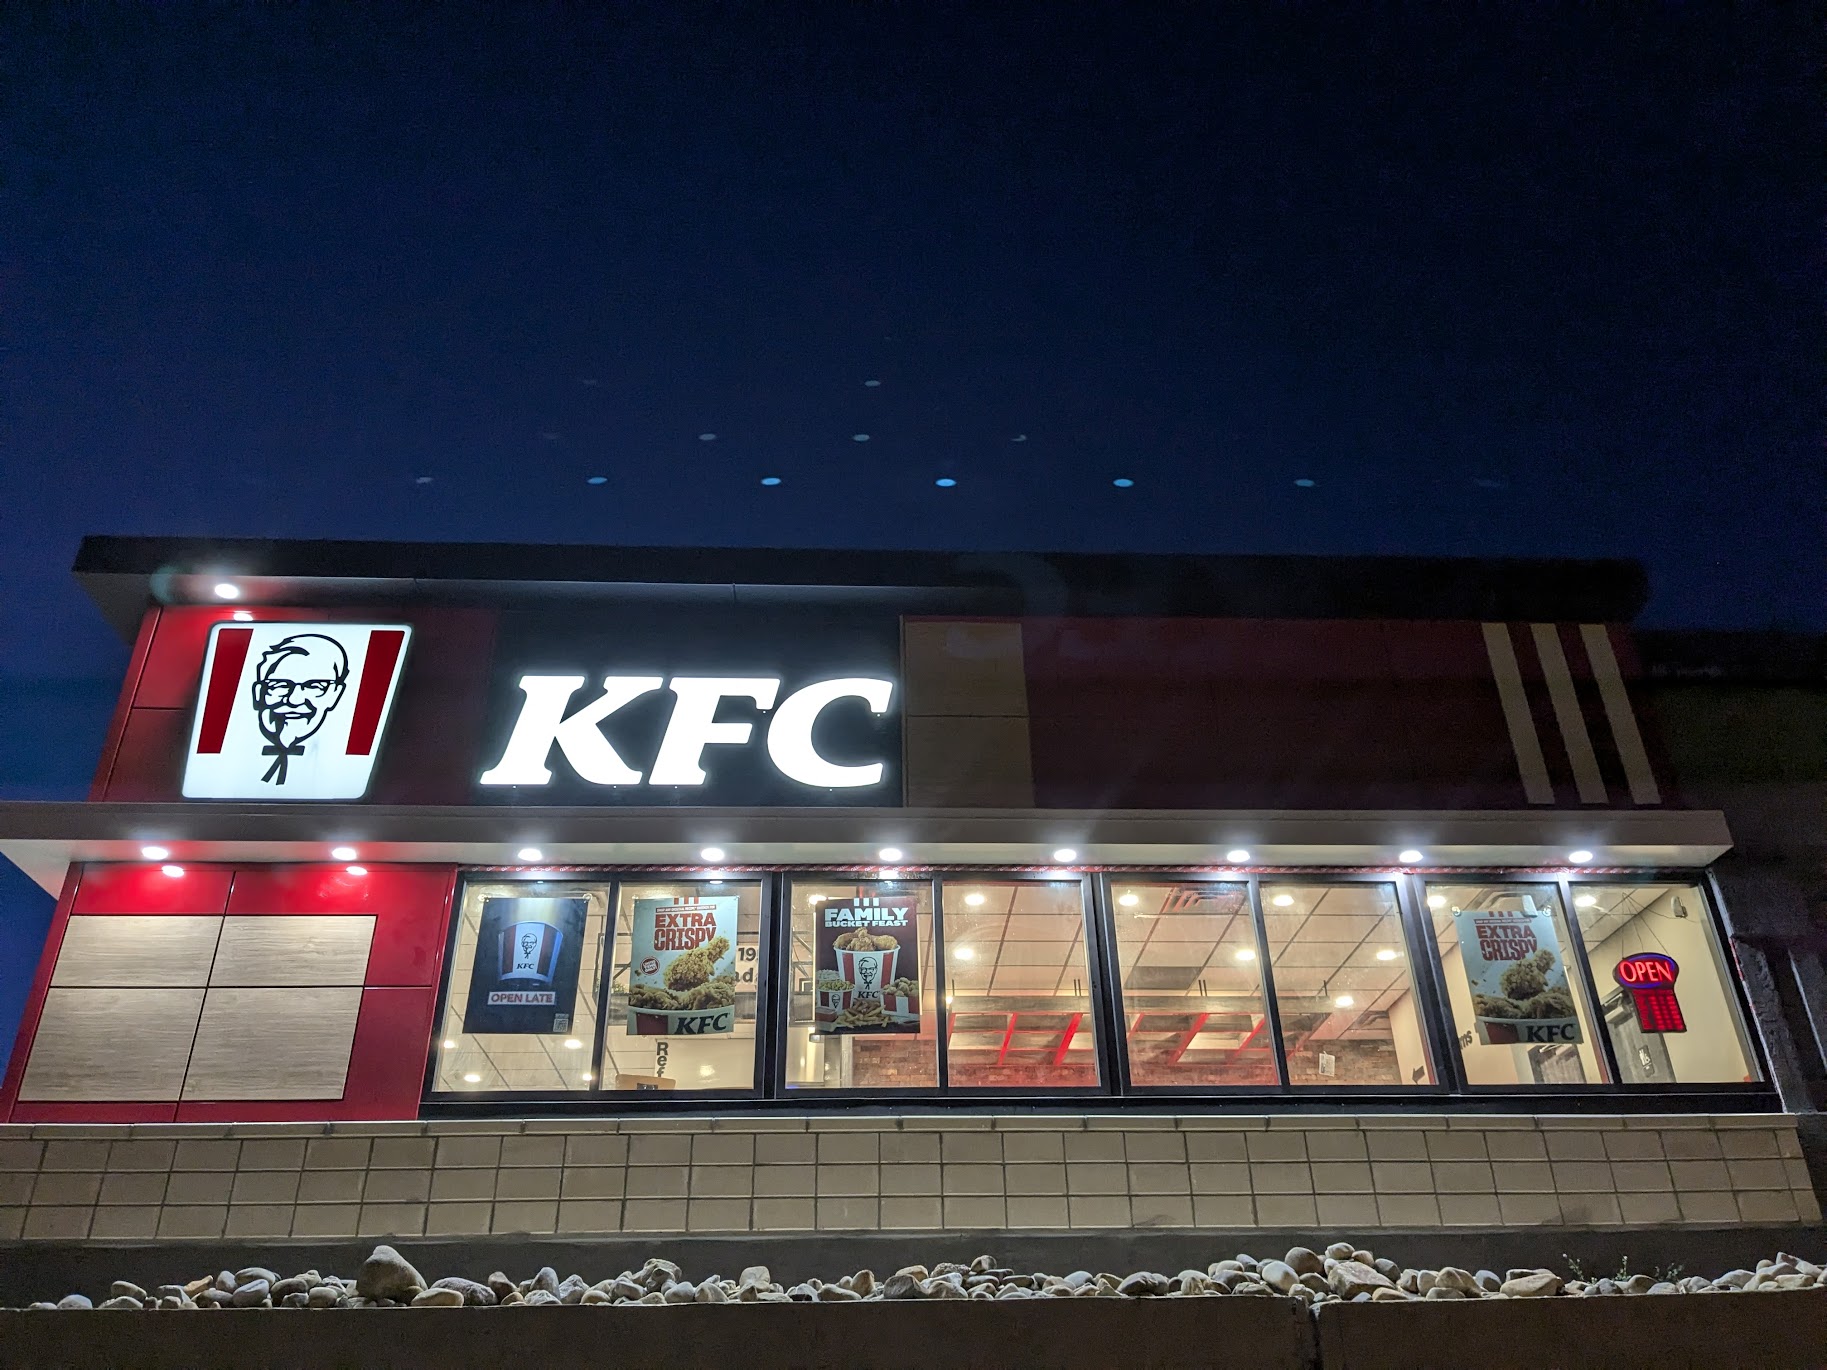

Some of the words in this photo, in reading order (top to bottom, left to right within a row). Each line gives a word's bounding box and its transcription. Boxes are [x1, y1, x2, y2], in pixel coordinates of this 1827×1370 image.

[479, 675, 894, 788] KFC
[655, 912, 717, 928] EXTRA
[825, 907, 909, 920] FAMILY
[654, 927, 717, 951] CRISPY
[1476, 925, 1536, 938] EXTRA
[738, 947, 758, 962] 19
[1481, 939, 1537, 961] CRISPY
[1619, 961, 1673, 982] OPEN
[491, 993, 522, 1003] OPEN
[525, 993, 553, 1003] LATE
[674, 1012, 729, 1035] KFC
[1525, 1025, 1574, 1043] KFC
